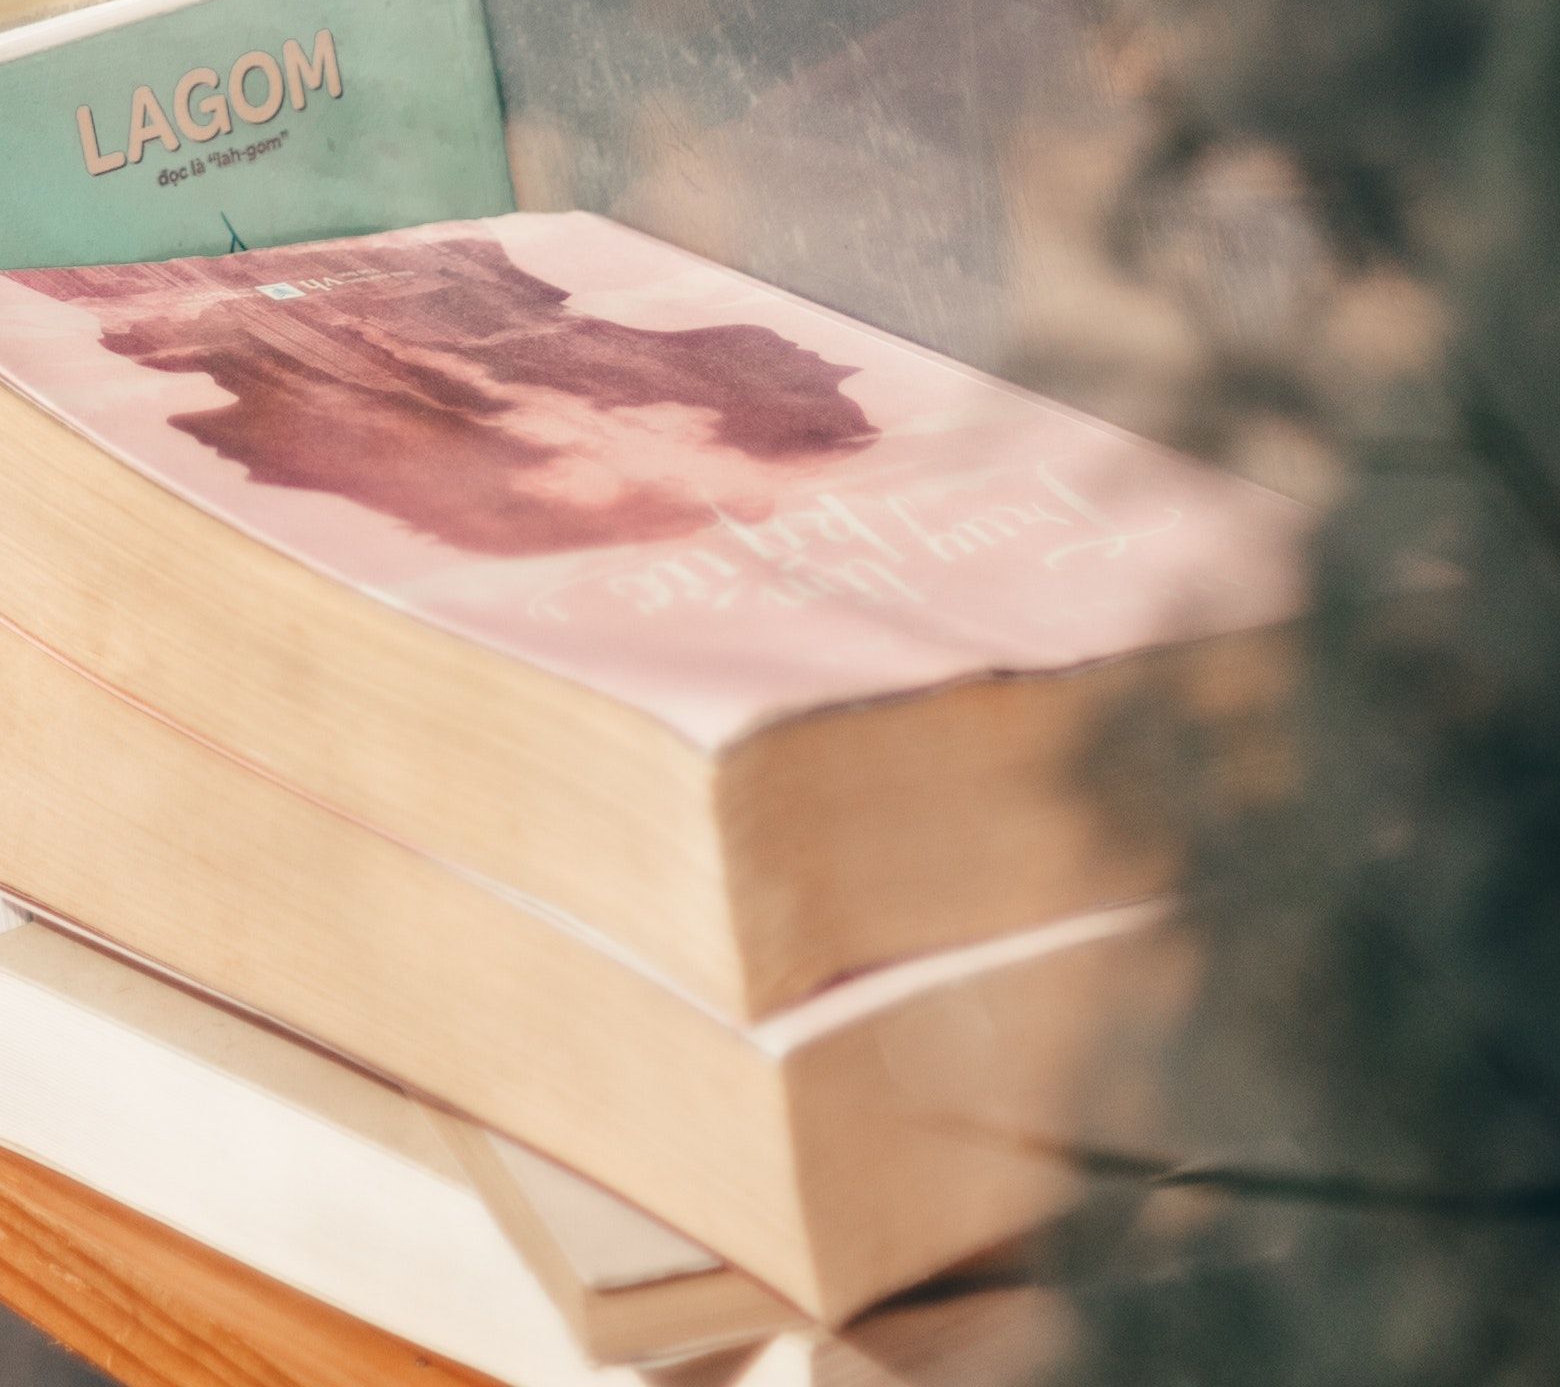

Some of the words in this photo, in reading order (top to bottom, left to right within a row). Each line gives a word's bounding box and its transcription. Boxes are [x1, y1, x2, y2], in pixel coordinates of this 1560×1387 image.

[76, 29, 342, 177] LAGOM
[158, 163, 189, 187] đọc
[190, 158, 207, 176] là
